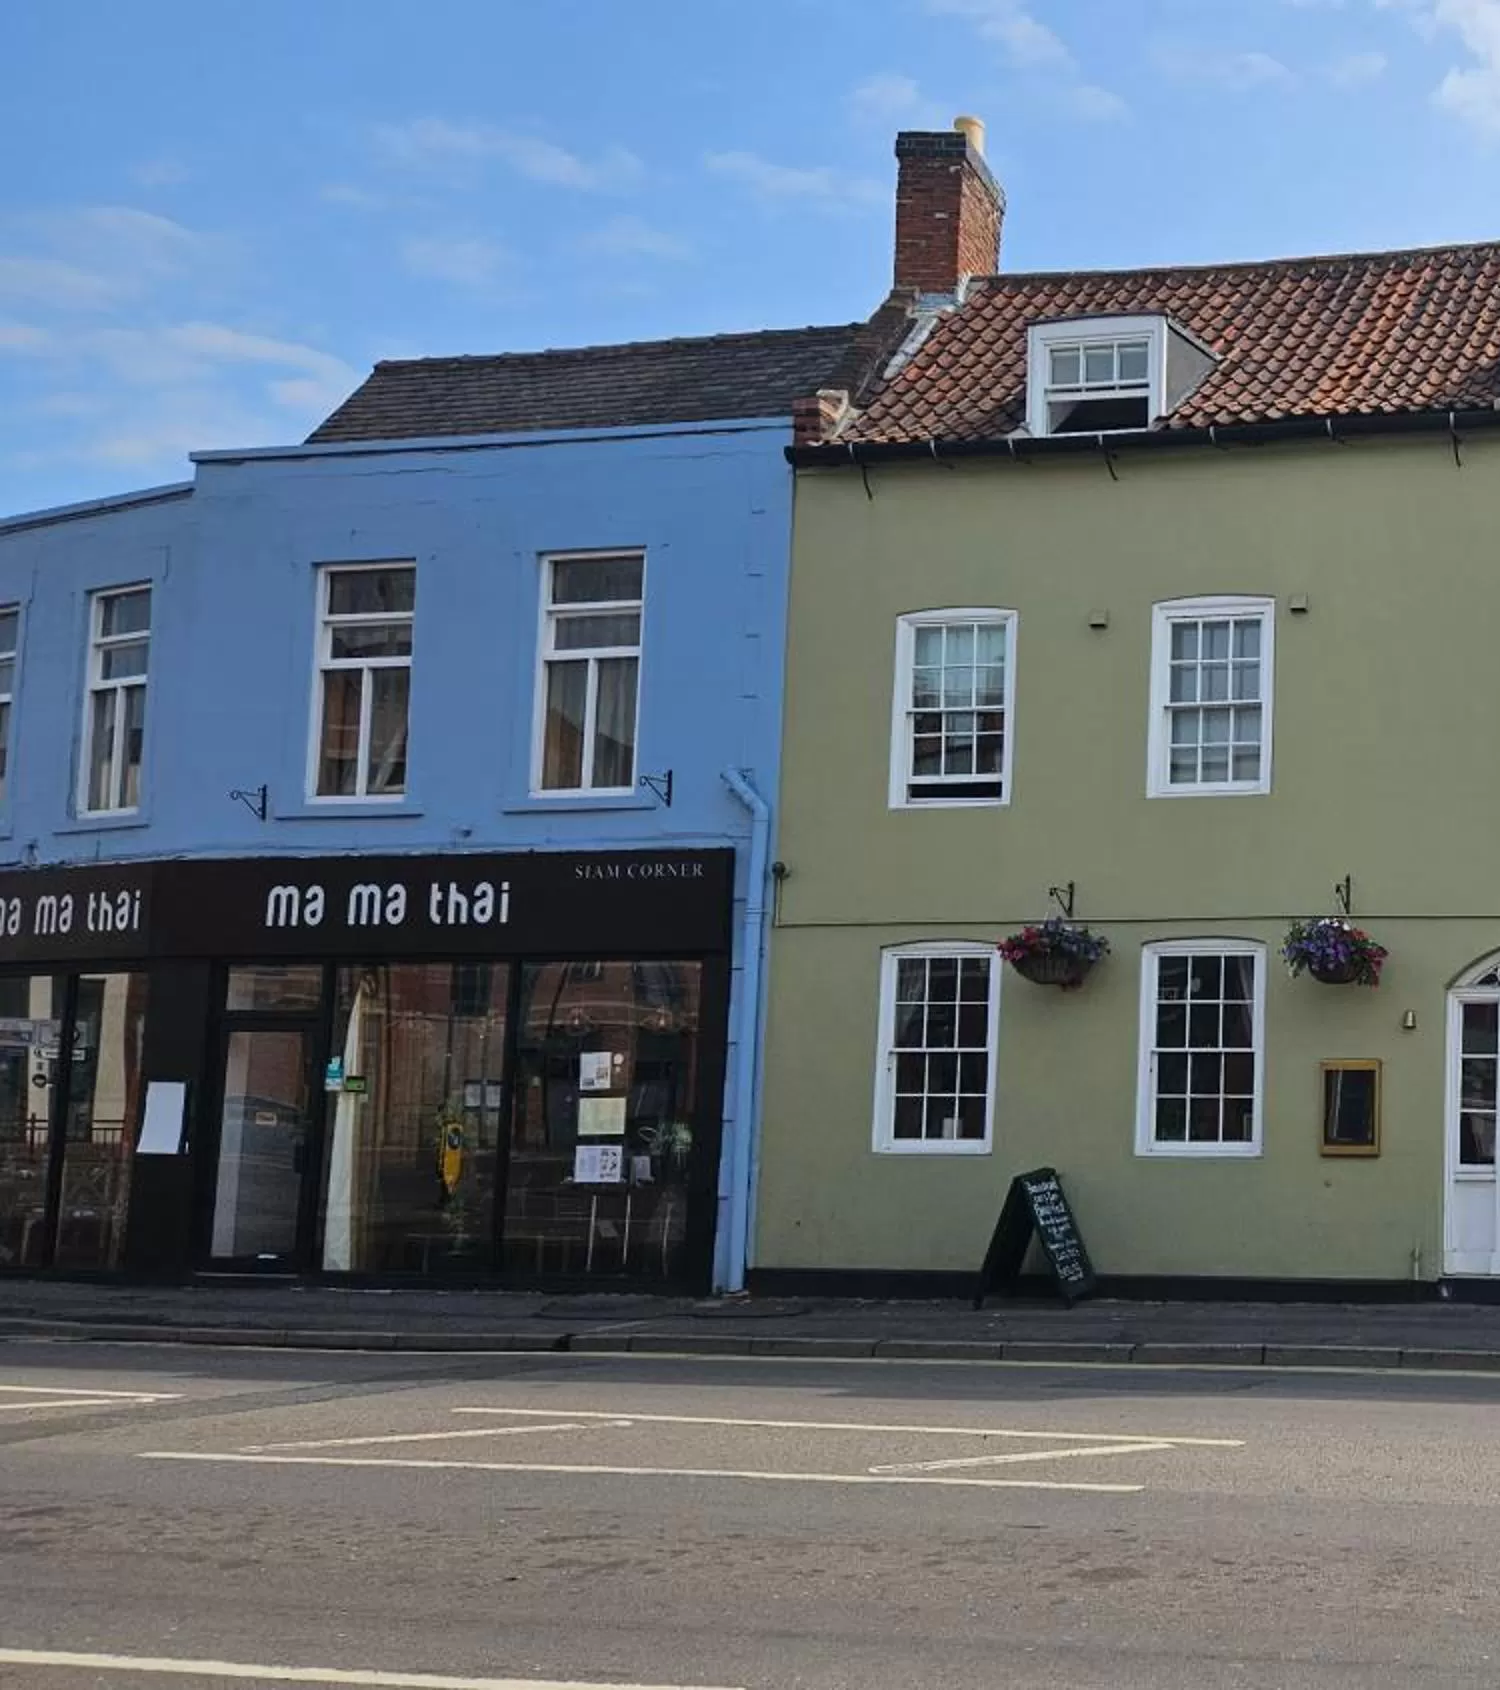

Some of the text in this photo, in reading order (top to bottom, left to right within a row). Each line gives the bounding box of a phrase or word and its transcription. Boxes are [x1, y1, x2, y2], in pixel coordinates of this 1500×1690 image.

[575, 862, 705, 880] SIAM CORNER
[34, 893, 73, 934] ma
[87, 890, 140, 931] thai
[265, 881, 510, 927] ma ma thai
